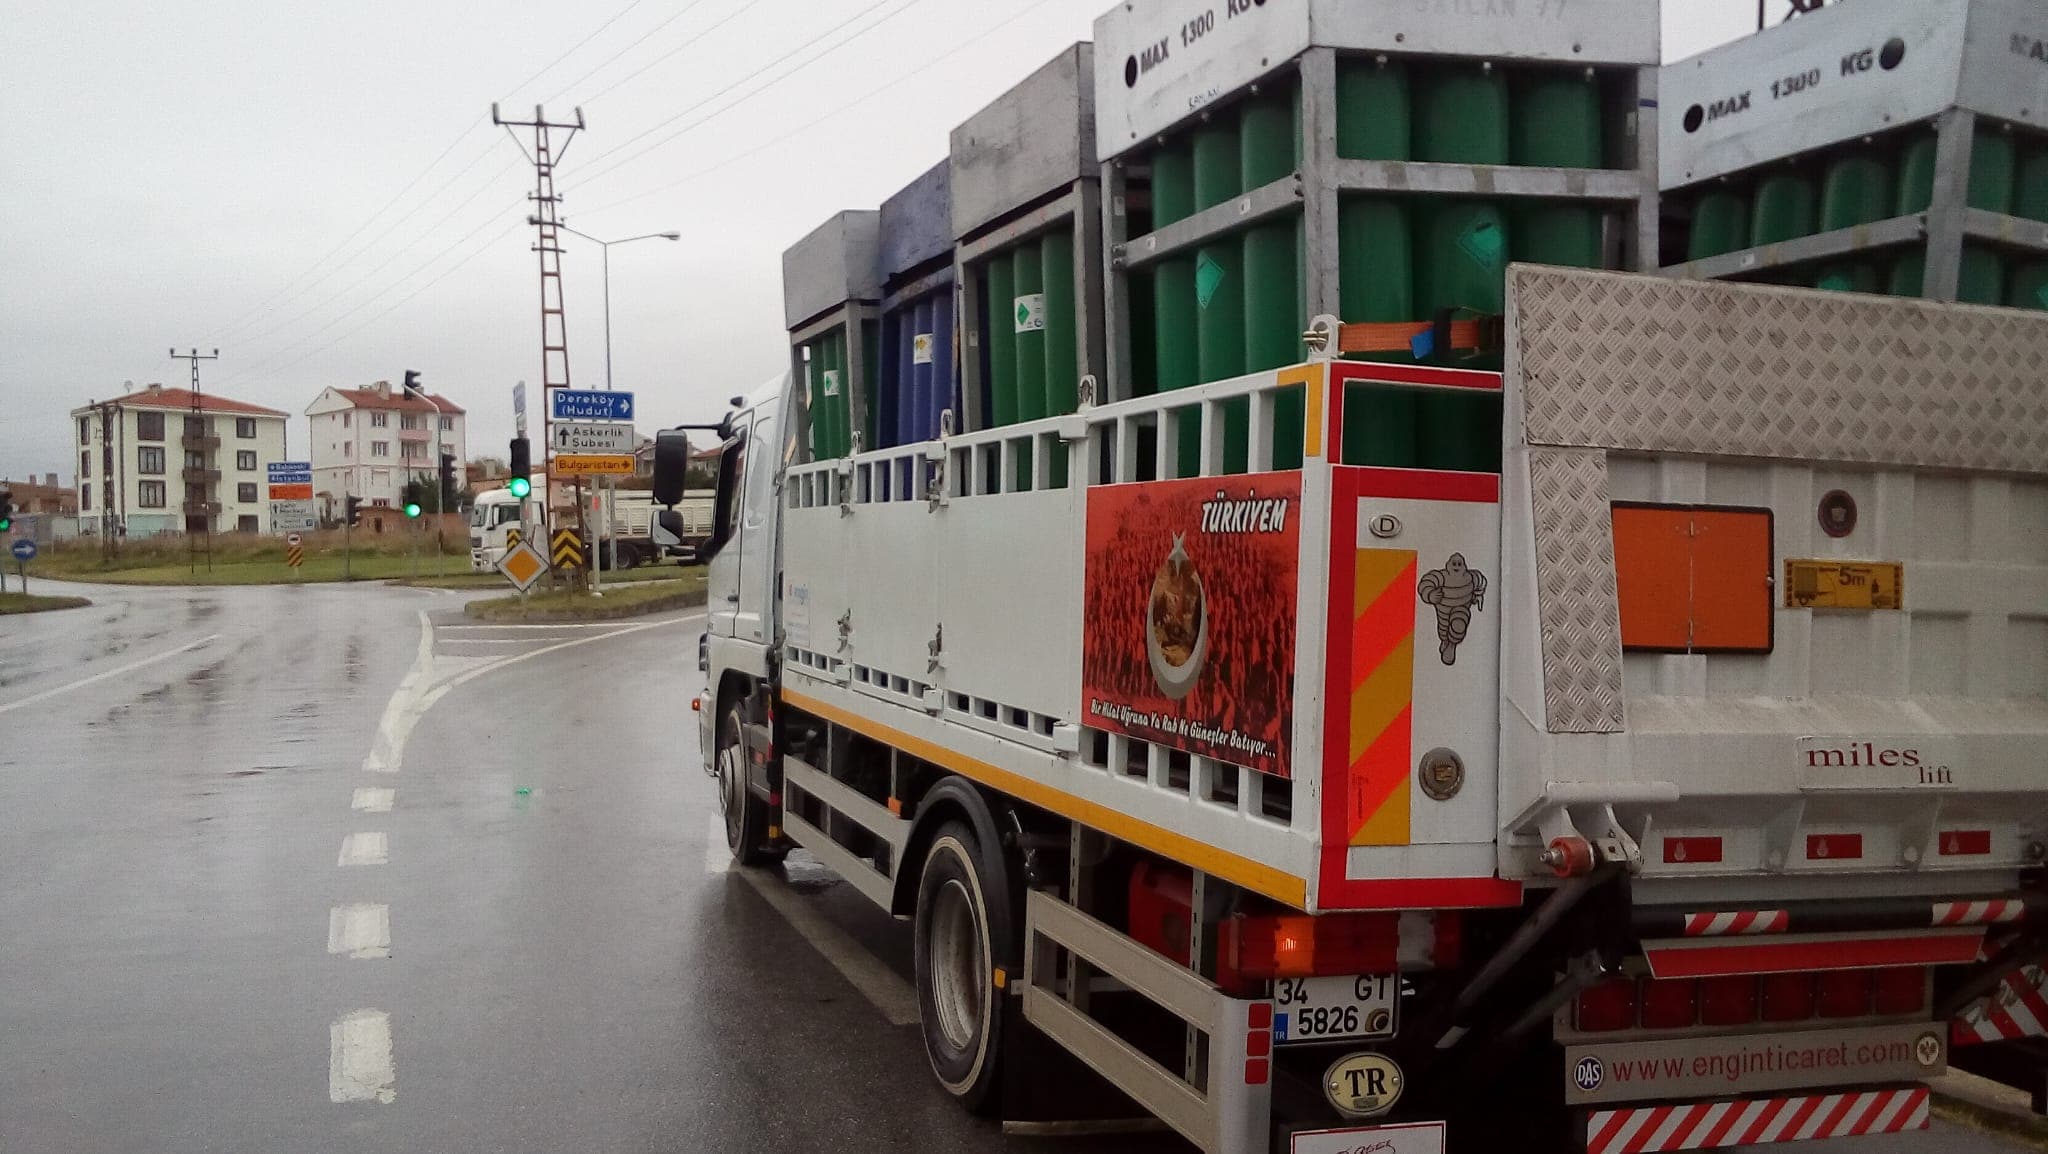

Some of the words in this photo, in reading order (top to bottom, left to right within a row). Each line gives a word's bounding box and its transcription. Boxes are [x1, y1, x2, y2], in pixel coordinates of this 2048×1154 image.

[1140, 36, 1169, 74] MAX
[1181, 9, 1214, 48] 1300
[1707, 90, 1751, 122] MAX
[1770, 68, 1821, 100] 1300
[1841, 48, 1874, 77] KG
[557, 393, 615, 407] Dereköy
[562, 405, 613, 418] (Hudut)
[572, 427, 624, 438] Askerlik
[559, 460, 620, 472] Bulgaristan
[1201, 488, 1288, 533] TÜRKİYEM
[1380, 518, 1395, 532] D
[1091, 698, 1102, 714] Bir
[1102, 701, 1120, 719] Hilal
[1121, 705, 1149, 727] Uğruna
[1151, 711, 1160, 729] Ya
[1162, 714, 1178, 734] Rab
[1179, 718, 1188, 736] Ne
[1190, 721, 1229, 747] Güneşler
[1806, 742, 1920, 767] miles
[1919, 765, 1953, 784] lift
[1278, 977, 1309, 1005] 34
[1354, 974, 1392, 1001] GT
[1298, 1005, 1360, 1036] 5826
[1274, 1031, 1286, 1040] TR
[1577, 1061, 1601, 1086] DAS
[1612, 1040, 1910, 1082] www.enginticaret.com
[1344, 1067, 1388, 1098] TR
